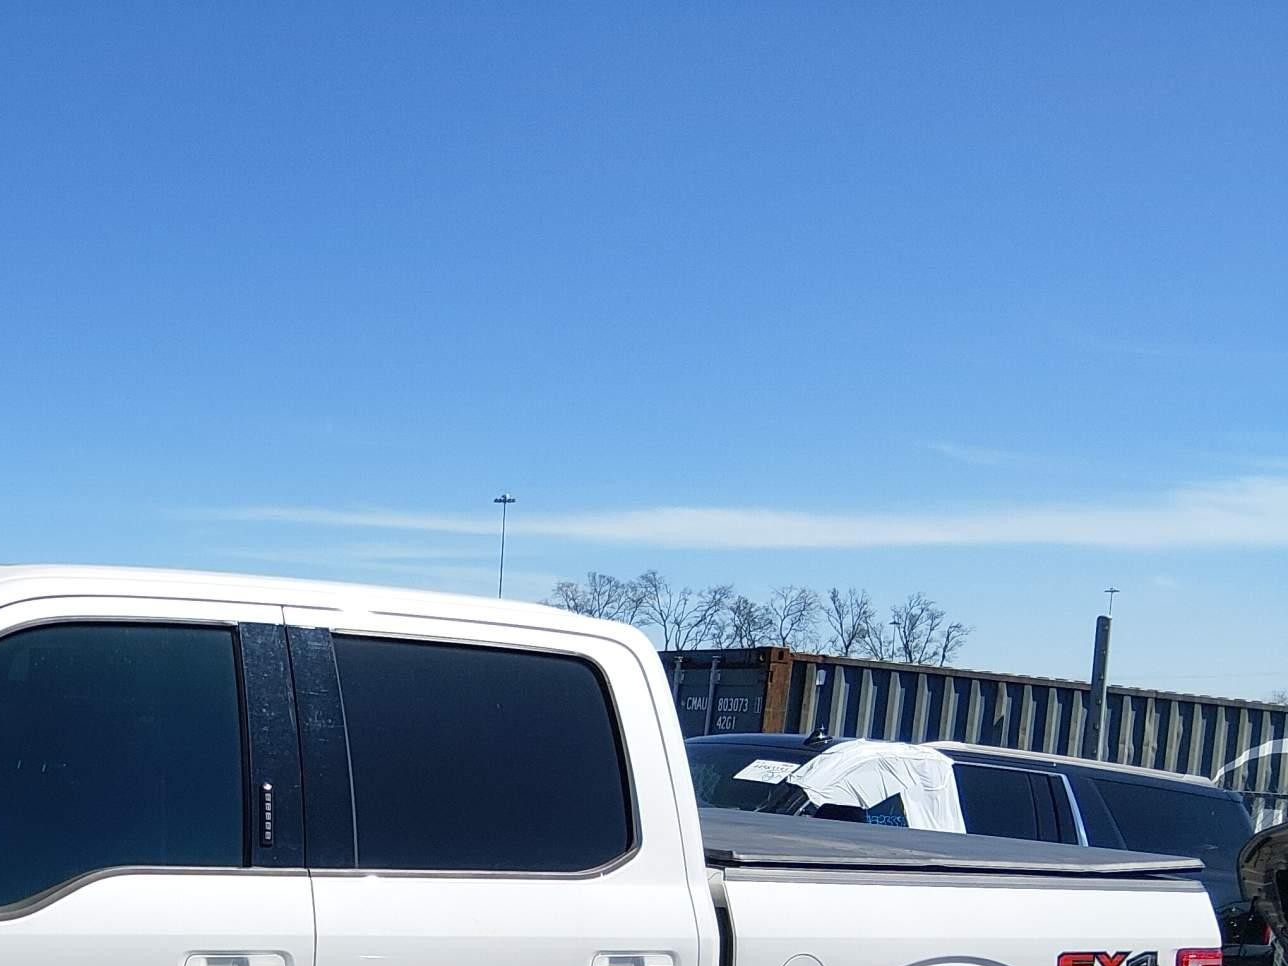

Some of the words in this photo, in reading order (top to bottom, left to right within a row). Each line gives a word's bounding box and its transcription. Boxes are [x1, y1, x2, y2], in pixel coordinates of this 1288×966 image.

[686, 696, 708, 710] CMAU
[717, 697, 748, 713] 803073
[716, 715, 736, 730] 42G1
